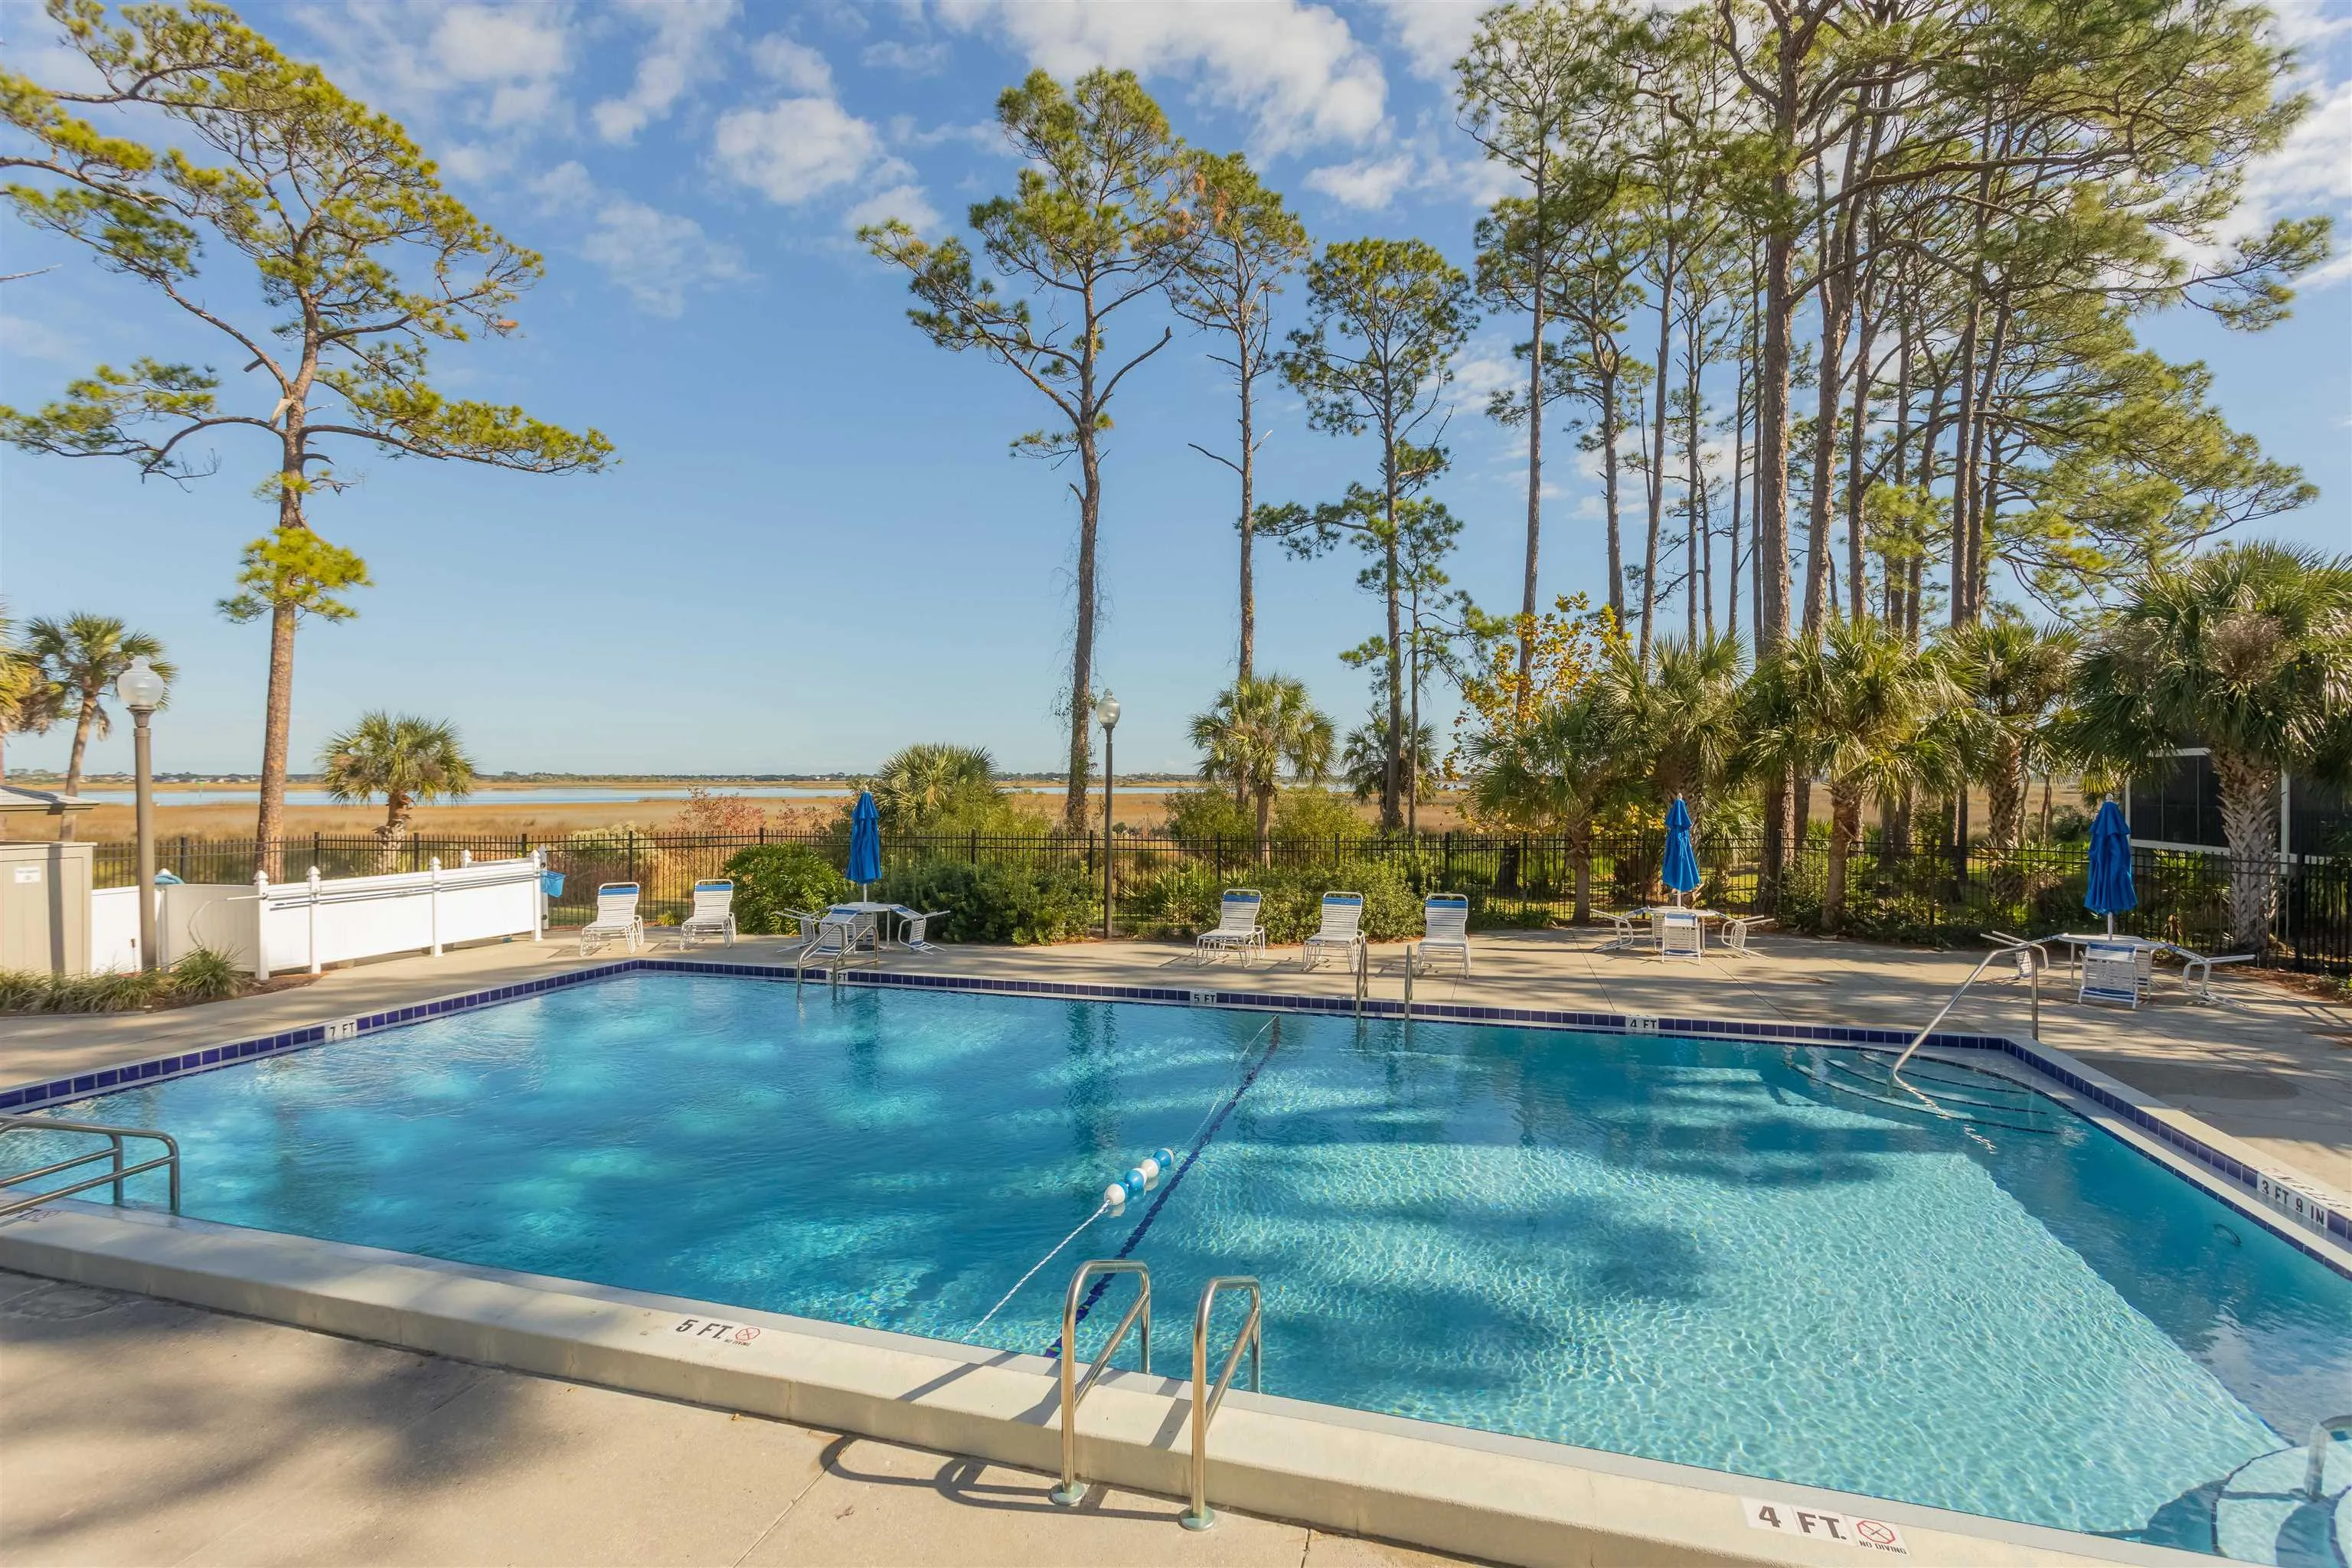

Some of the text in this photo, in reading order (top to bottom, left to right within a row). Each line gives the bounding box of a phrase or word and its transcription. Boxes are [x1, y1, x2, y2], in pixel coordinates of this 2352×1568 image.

[829, 972, 847, 981] 7 FT
[1194, 994, 1216, 1002] 5 FT
[330, 1022, 354, 1037] 7 FT
[1629, 1019, 1657, 1029] 4 FT
[2261, 1180, 2324, 1225] 3 FT 9 IN
[675, 1318, 734, 1340] 5 FT.
[1759, 1505, 1847, 1540] 4 FT.
[1858, 1540, 1908, 1555] NO DIVING
